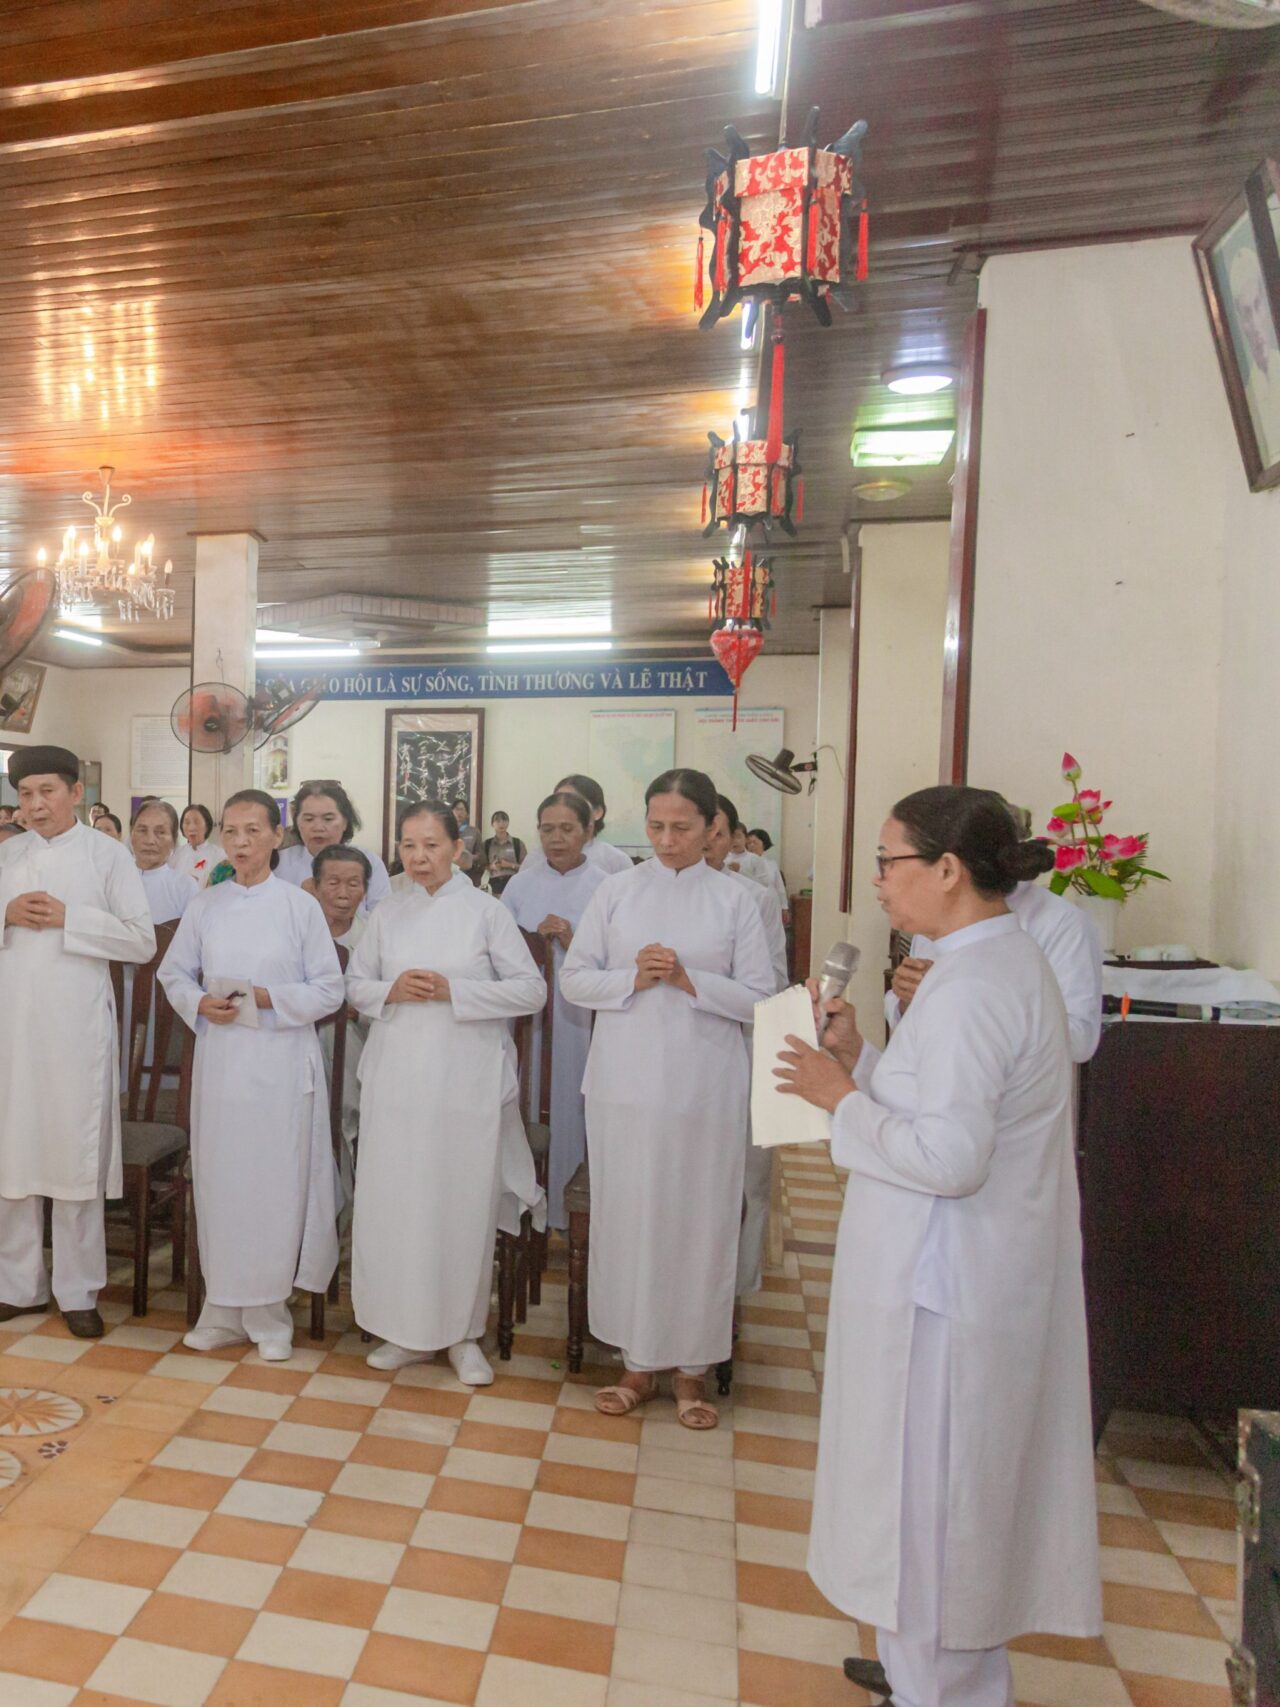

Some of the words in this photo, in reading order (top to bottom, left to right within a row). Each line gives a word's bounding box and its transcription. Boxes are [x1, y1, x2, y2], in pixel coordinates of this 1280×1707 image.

[344, 673, 372, 696] HỘI
[376, 672, 397, 693] LÀ
[402, 674, 422, 696] SỰ
[425, 668, 474, 693] SỐNG,
[478, 670, 519, 691] TÌNH
[523, 670, 595, 691] THƯƠNG
[600, 668, 624, 690] VÀ
[629, 668, 652, 689] LẼ
[658, 666, 708, 692] THẬT
